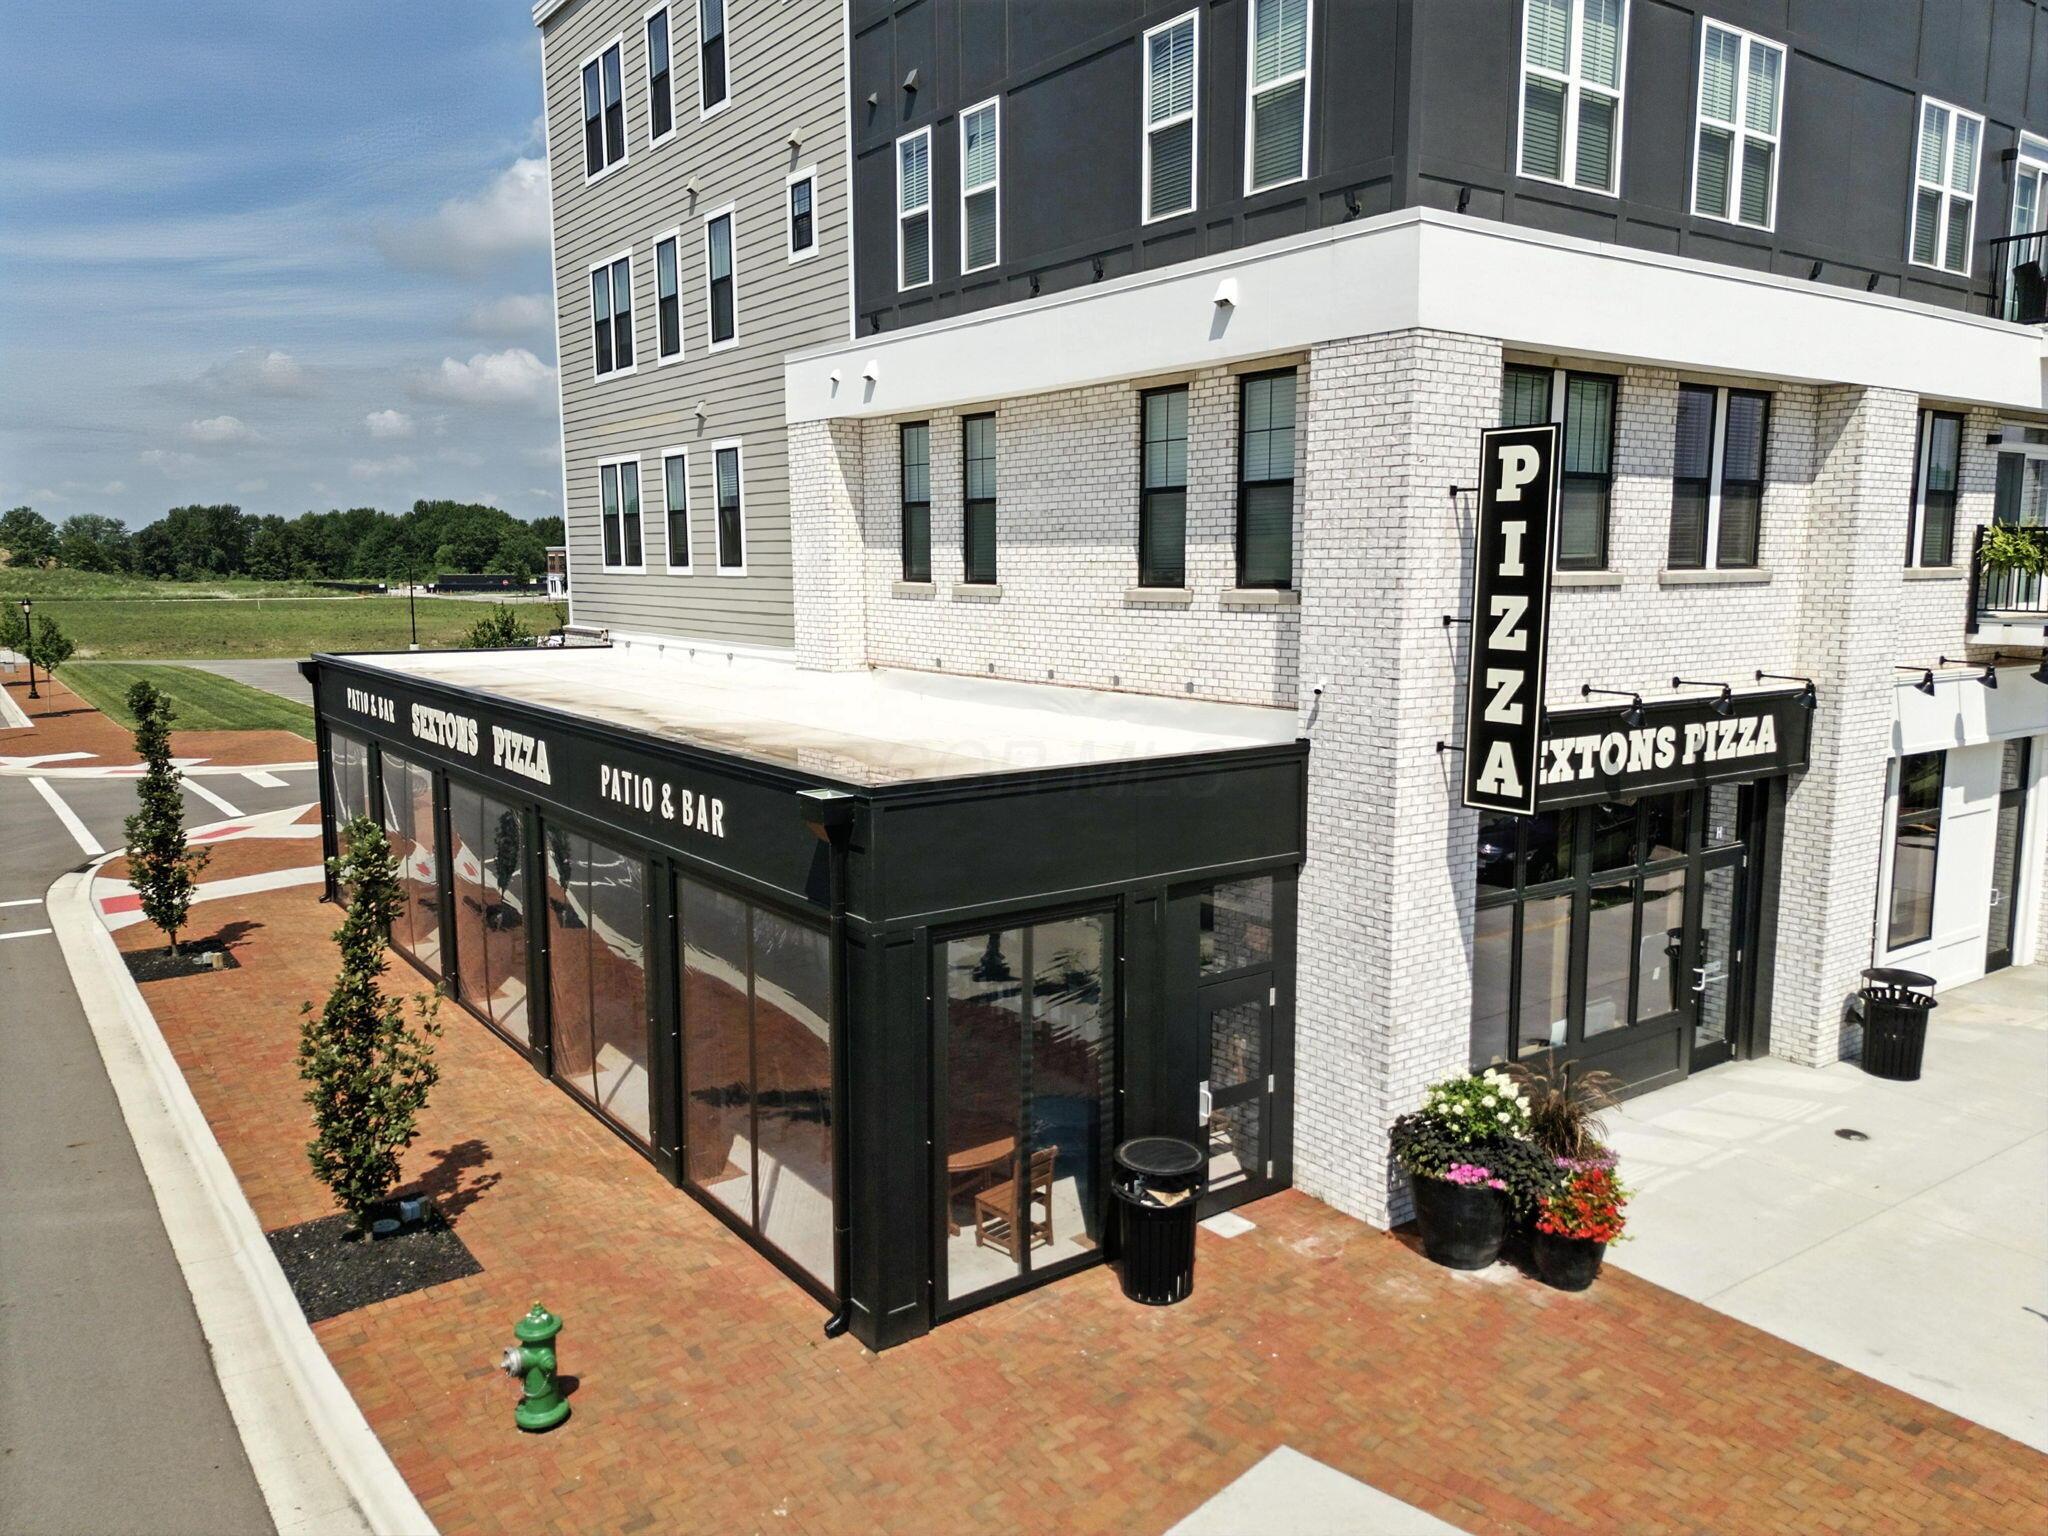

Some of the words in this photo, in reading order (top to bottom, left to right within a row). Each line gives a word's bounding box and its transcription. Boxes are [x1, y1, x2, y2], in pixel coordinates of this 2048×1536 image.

[1476, 444, 1541, 799] PIZZA
[346, 687, 369, 715] PATIO
[370, 694, 377, 717] &
[378, 696, 395, 724] BAR
[1682, 714, 1777, 765] PIZZA
[411, 702, 479, 757] SEXTONS
[491, 725, 551, 785] PIZZA
[601, 764, 653, 813] PATIO
[661, 783, 674, 820] &
[682, 789, 724, 838] BAR
